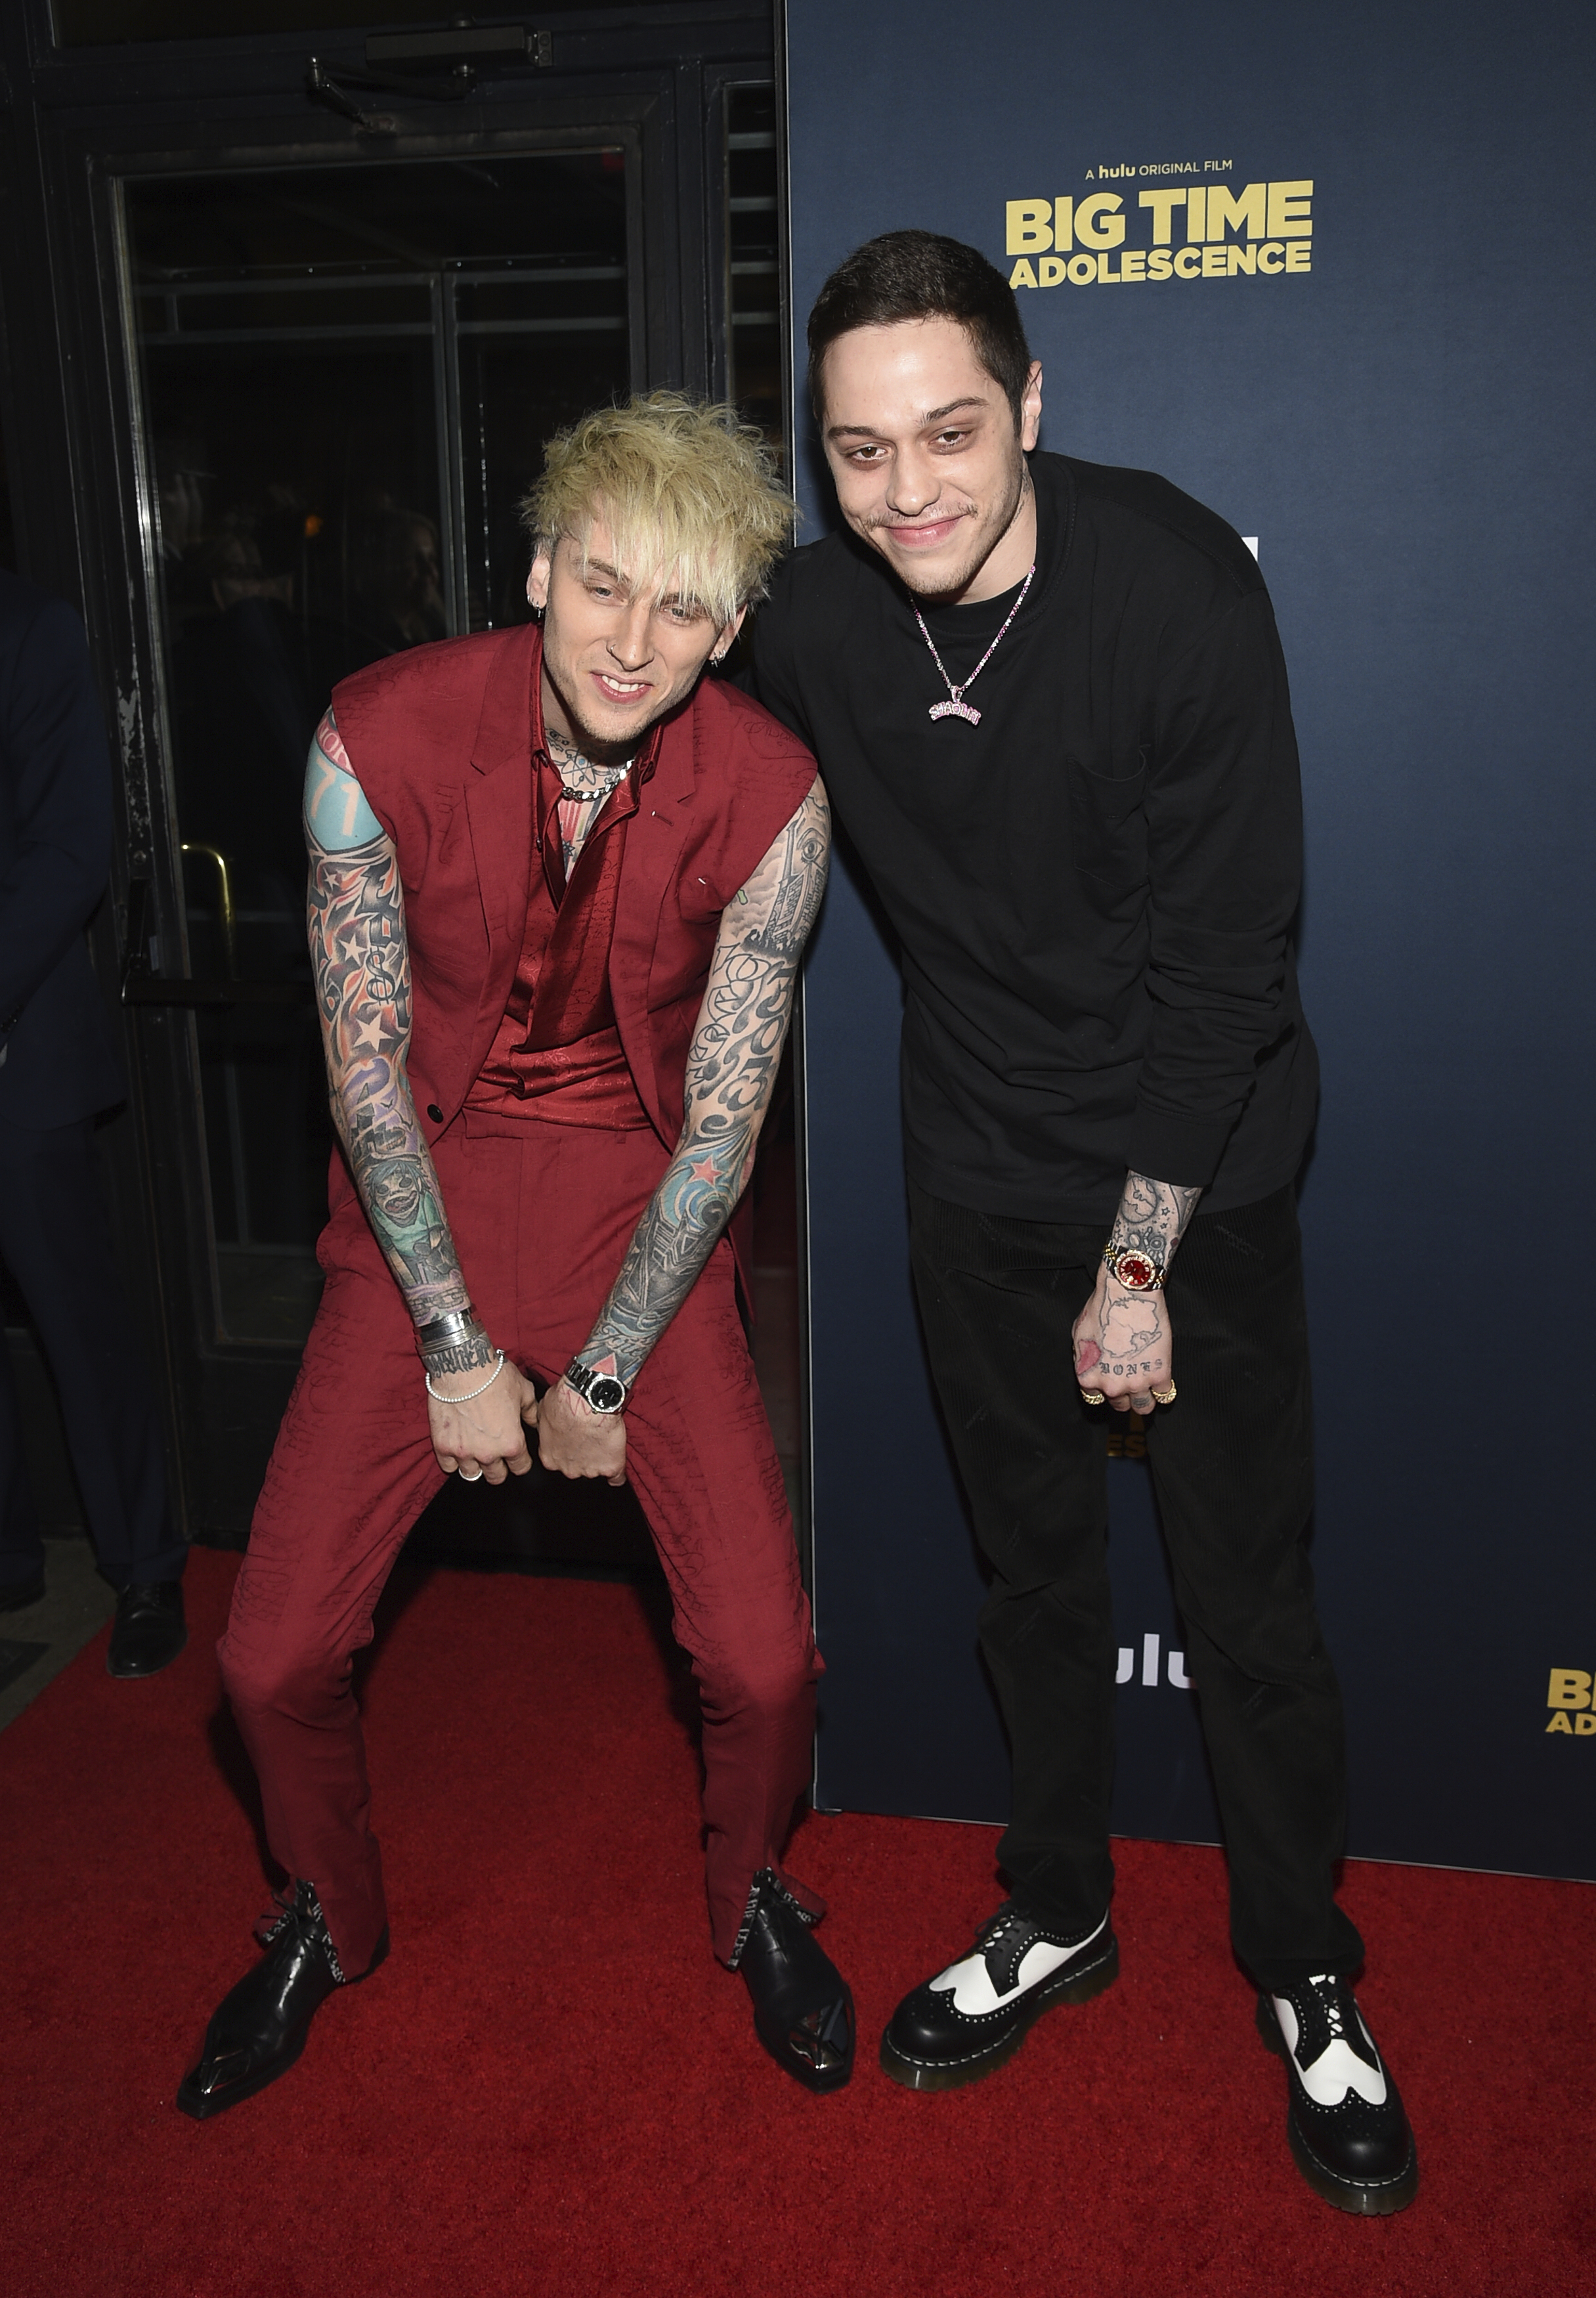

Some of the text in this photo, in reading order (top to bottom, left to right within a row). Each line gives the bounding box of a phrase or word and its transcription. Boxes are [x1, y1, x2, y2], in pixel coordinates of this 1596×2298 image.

[1085, 160, 1232, 180] A hulu ORIGINAL FILM
[1006, 180, 1313, 255] BIG TIME
[1008, 241, 1312, 290] ADOLESCENCE
